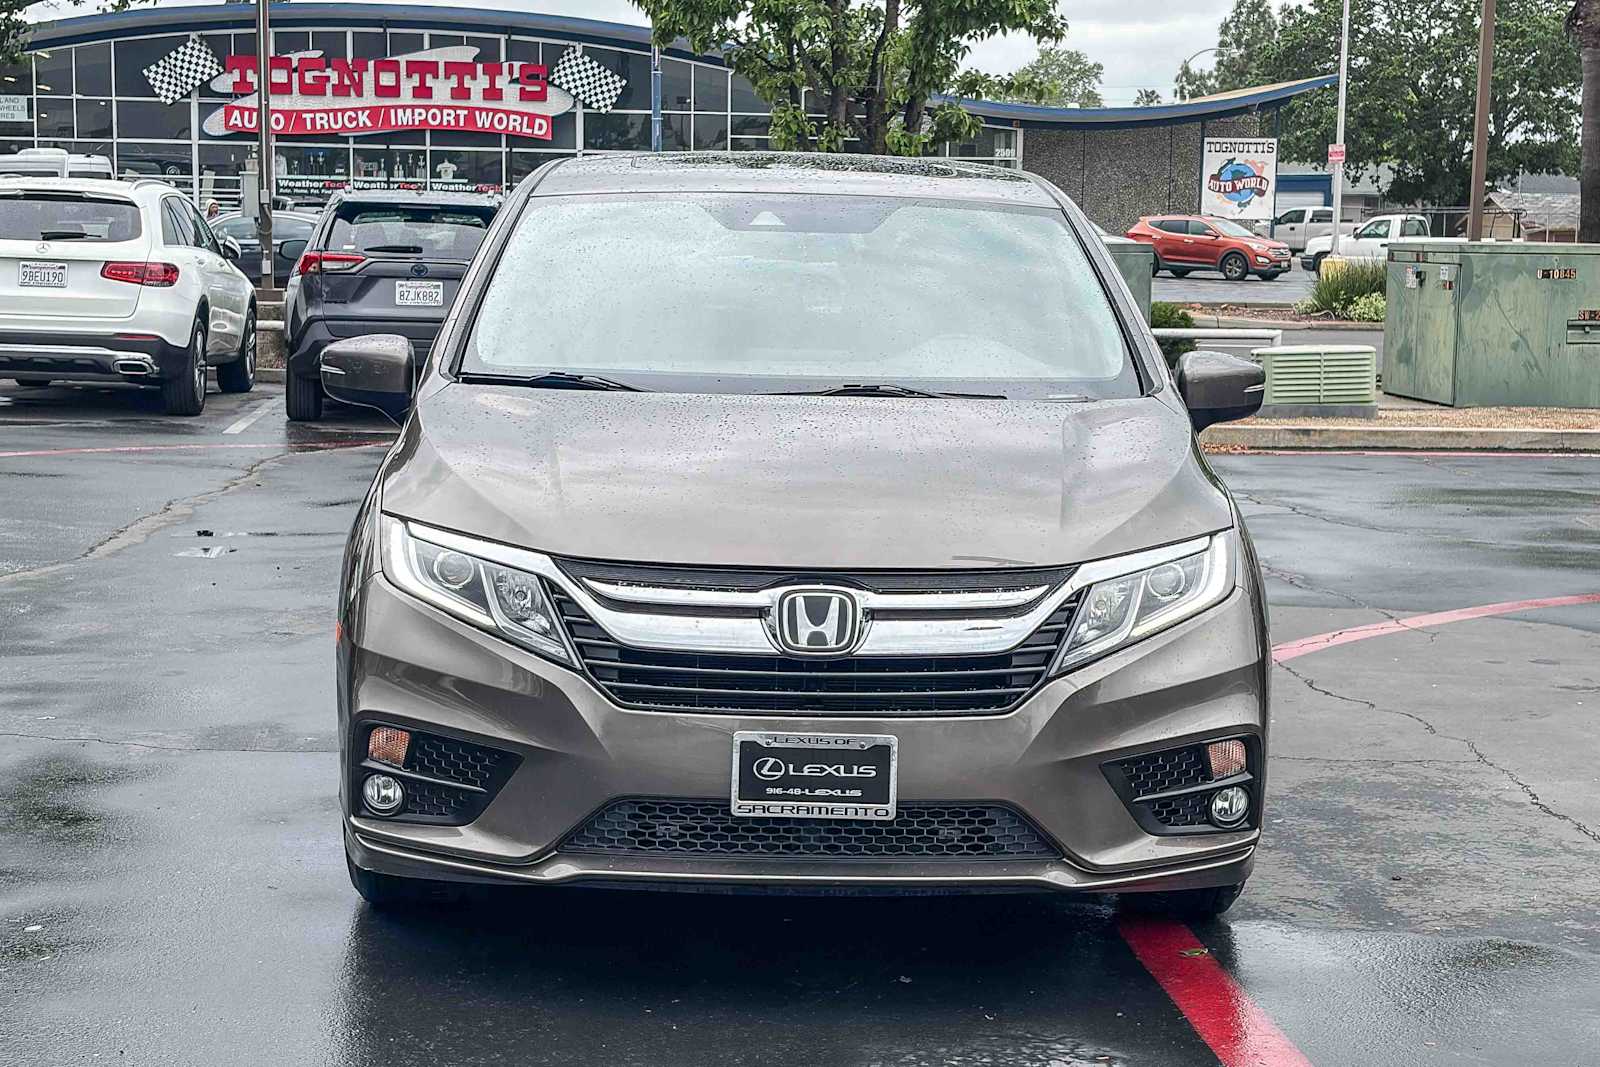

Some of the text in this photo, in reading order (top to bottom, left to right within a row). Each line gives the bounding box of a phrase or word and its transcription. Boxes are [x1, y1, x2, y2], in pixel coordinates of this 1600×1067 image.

[226, 55, 548, 101] TOGNOTTI'S
[228, 109, 285, 131] AUO
[301, 109, 372, 131] TRUCK
[390, 108, 468, 127] IMPORT
[475, 111, 548, 136] WORLD
[353, 181, 424, 189] WeatherTec
[1209, 177, 1267, 193] AUTO WORLD
[22, 270, 64, 283] 9BEU190
[774, 736, 857, 746] LEXUS OF
[788, 763, 877, 778] LEXUS
[766, 787, 863, 797] 916-48-LEXUS
[737, 804, 890, 817] SACRAMENTO
